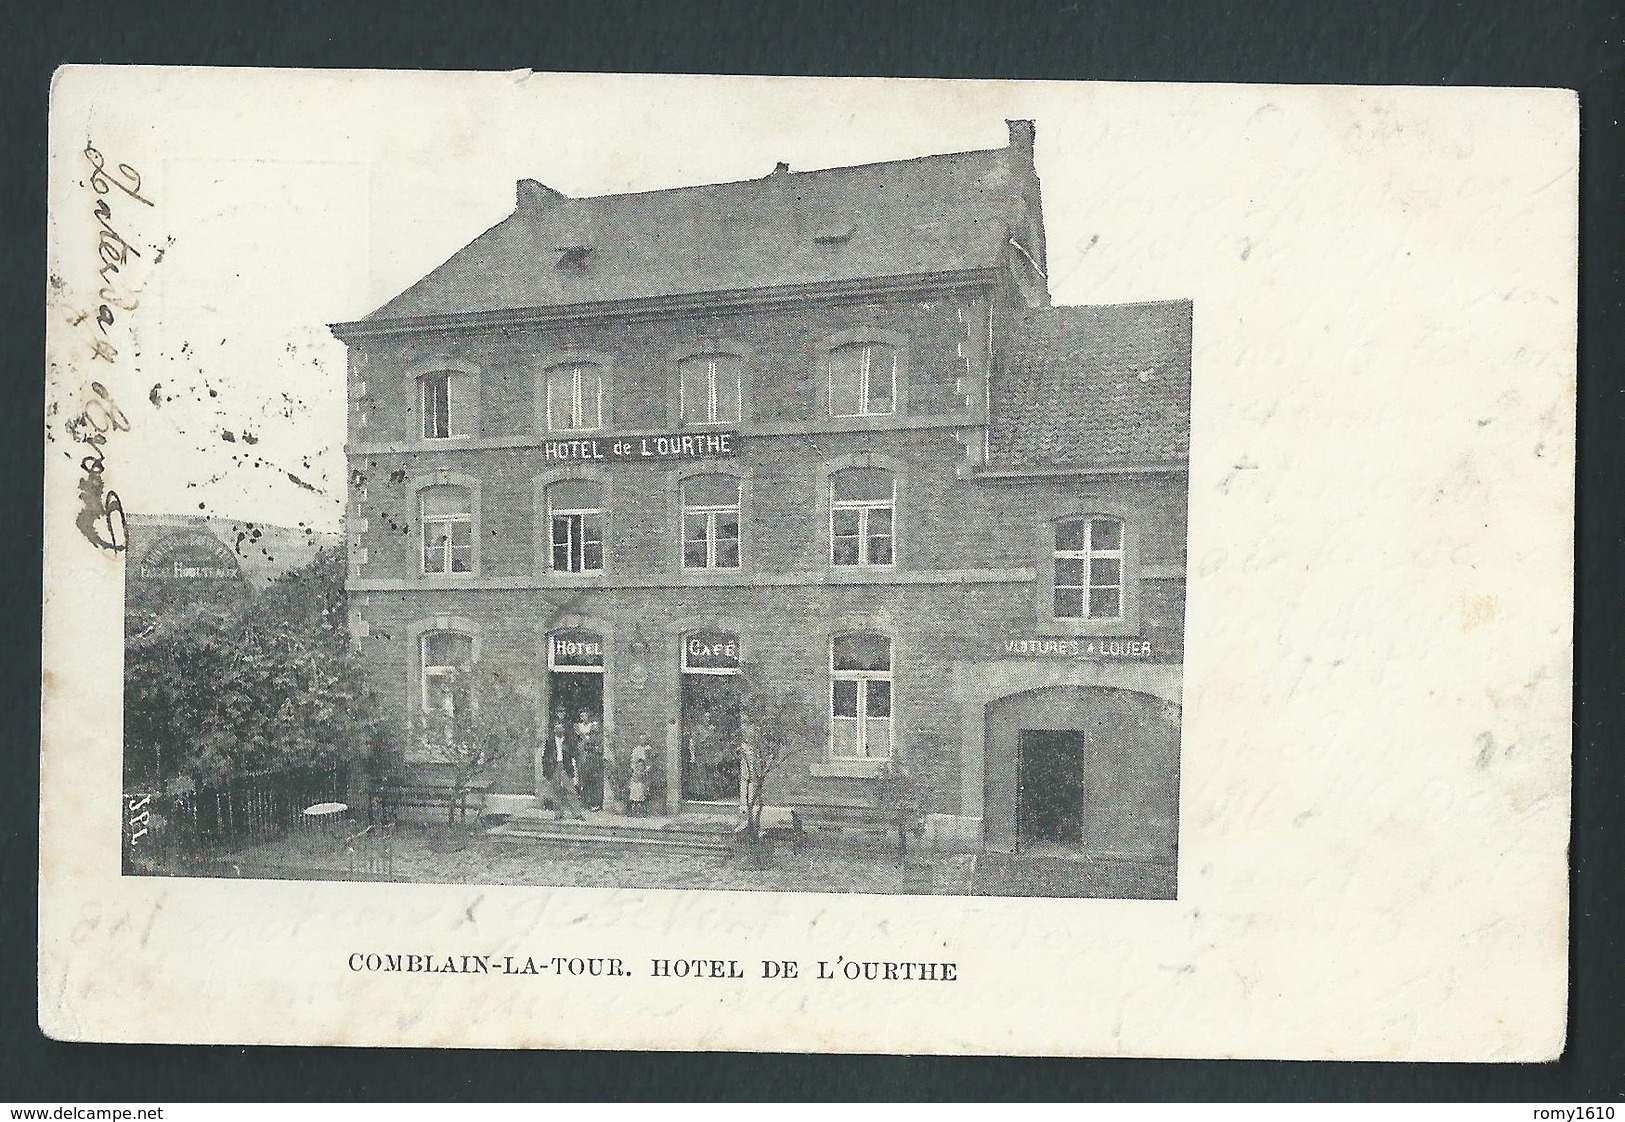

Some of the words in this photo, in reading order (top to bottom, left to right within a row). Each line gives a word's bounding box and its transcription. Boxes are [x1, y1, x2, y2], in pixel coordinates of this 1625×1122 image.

[545, 440, 604, 460] HOTEL
[613, 439, 632, 455] de
[641, 433, 731, 457] L'OURTHE
[555, 640, 603, 656] HOTEL
[1004, 639, 1080, 656] VOITURES
[1099, 640, 1152, 657] LOUER
[347, 952, 633, 978] COMBLAIN-LA-TOUR.
[650, 958, 744, 979] HOTEL
[760, 959, 799, 979] DE
[816, 954, 958, 982] L'OURTHE
